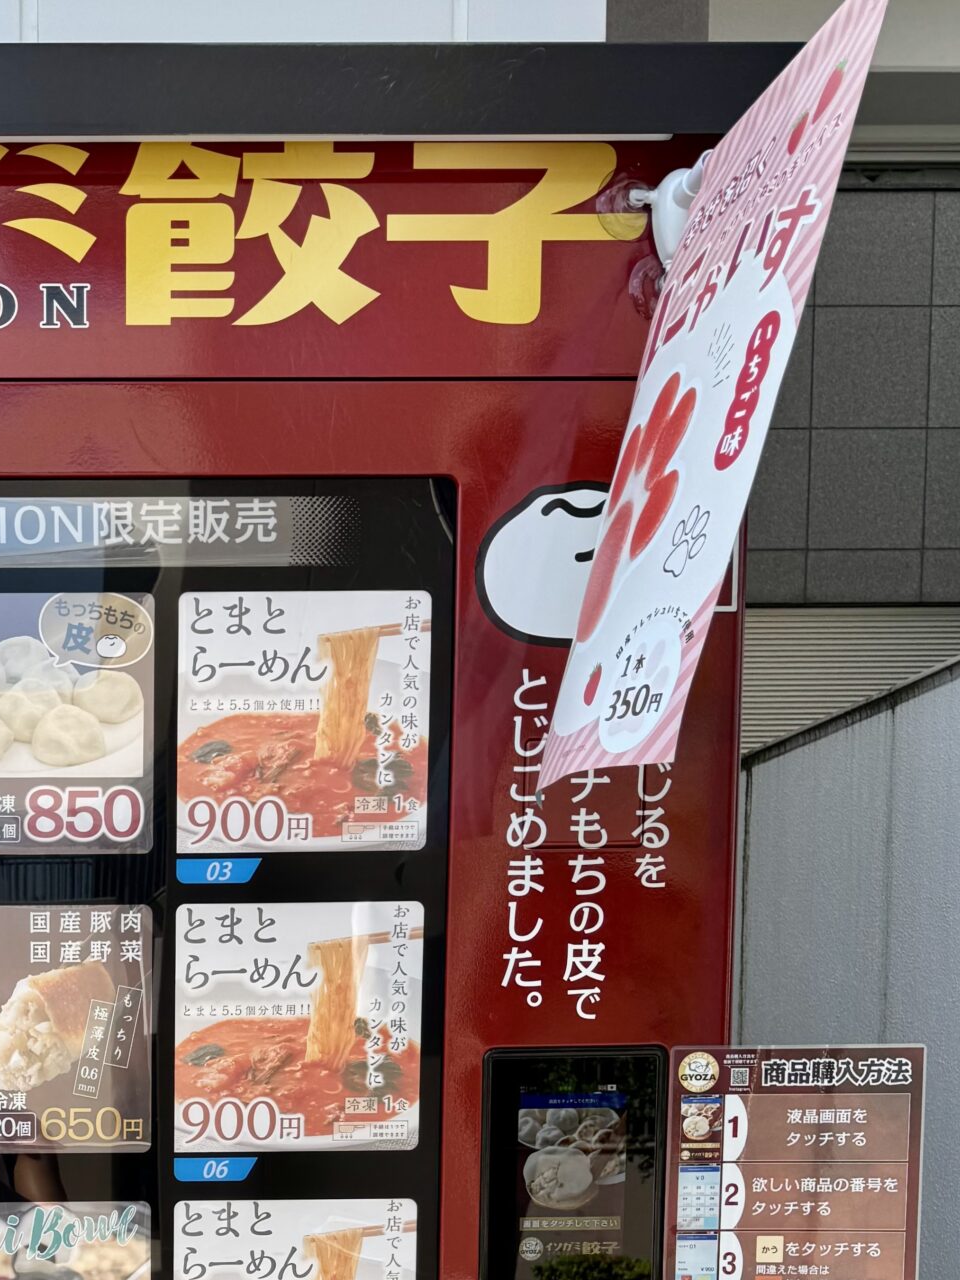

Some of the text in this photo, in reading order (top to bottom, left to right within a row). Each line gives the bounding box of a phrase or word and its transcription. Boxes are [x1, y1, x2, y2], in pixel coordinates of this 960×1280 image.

[642, 189, 818, 380] にゃいす
[721, 328, 771, 455] いちご味
[189, 596, 287, 636] とまと
[191, 646, 328, 684] らーめん
[400, 596, 422, 749] お店で人気の味が
[605, 683, 663, 722] 350円
[377, 692, 393, 784] カンタンに
[25, 787, 143, 840] 850
[187, 799, 310, 845] 900円
[206, 862, 232, 881] 03
[680, 1073, 716, 1081] GYOZA
[762, 1058, 912, 1086] 商品購入方法
[728, 1116, 738, 1138] 1
[786, 1109, 868, 1124] 液晶画面を
[786, 1132, 867, 1147] タッチする
[203, 1161, 229, 1179] 06
[725, 1183, 738, 1206] 2
[752, 1177, 899, 1193] 欲しい商品の番号を
[752, 1201, 831, 1216] タッチする
[761, 1242, 881, 1257] かう をタッチする
[722, 1251, 736, 1275] 3
[756, 1265, 830, 1275] 間違えた場合は
